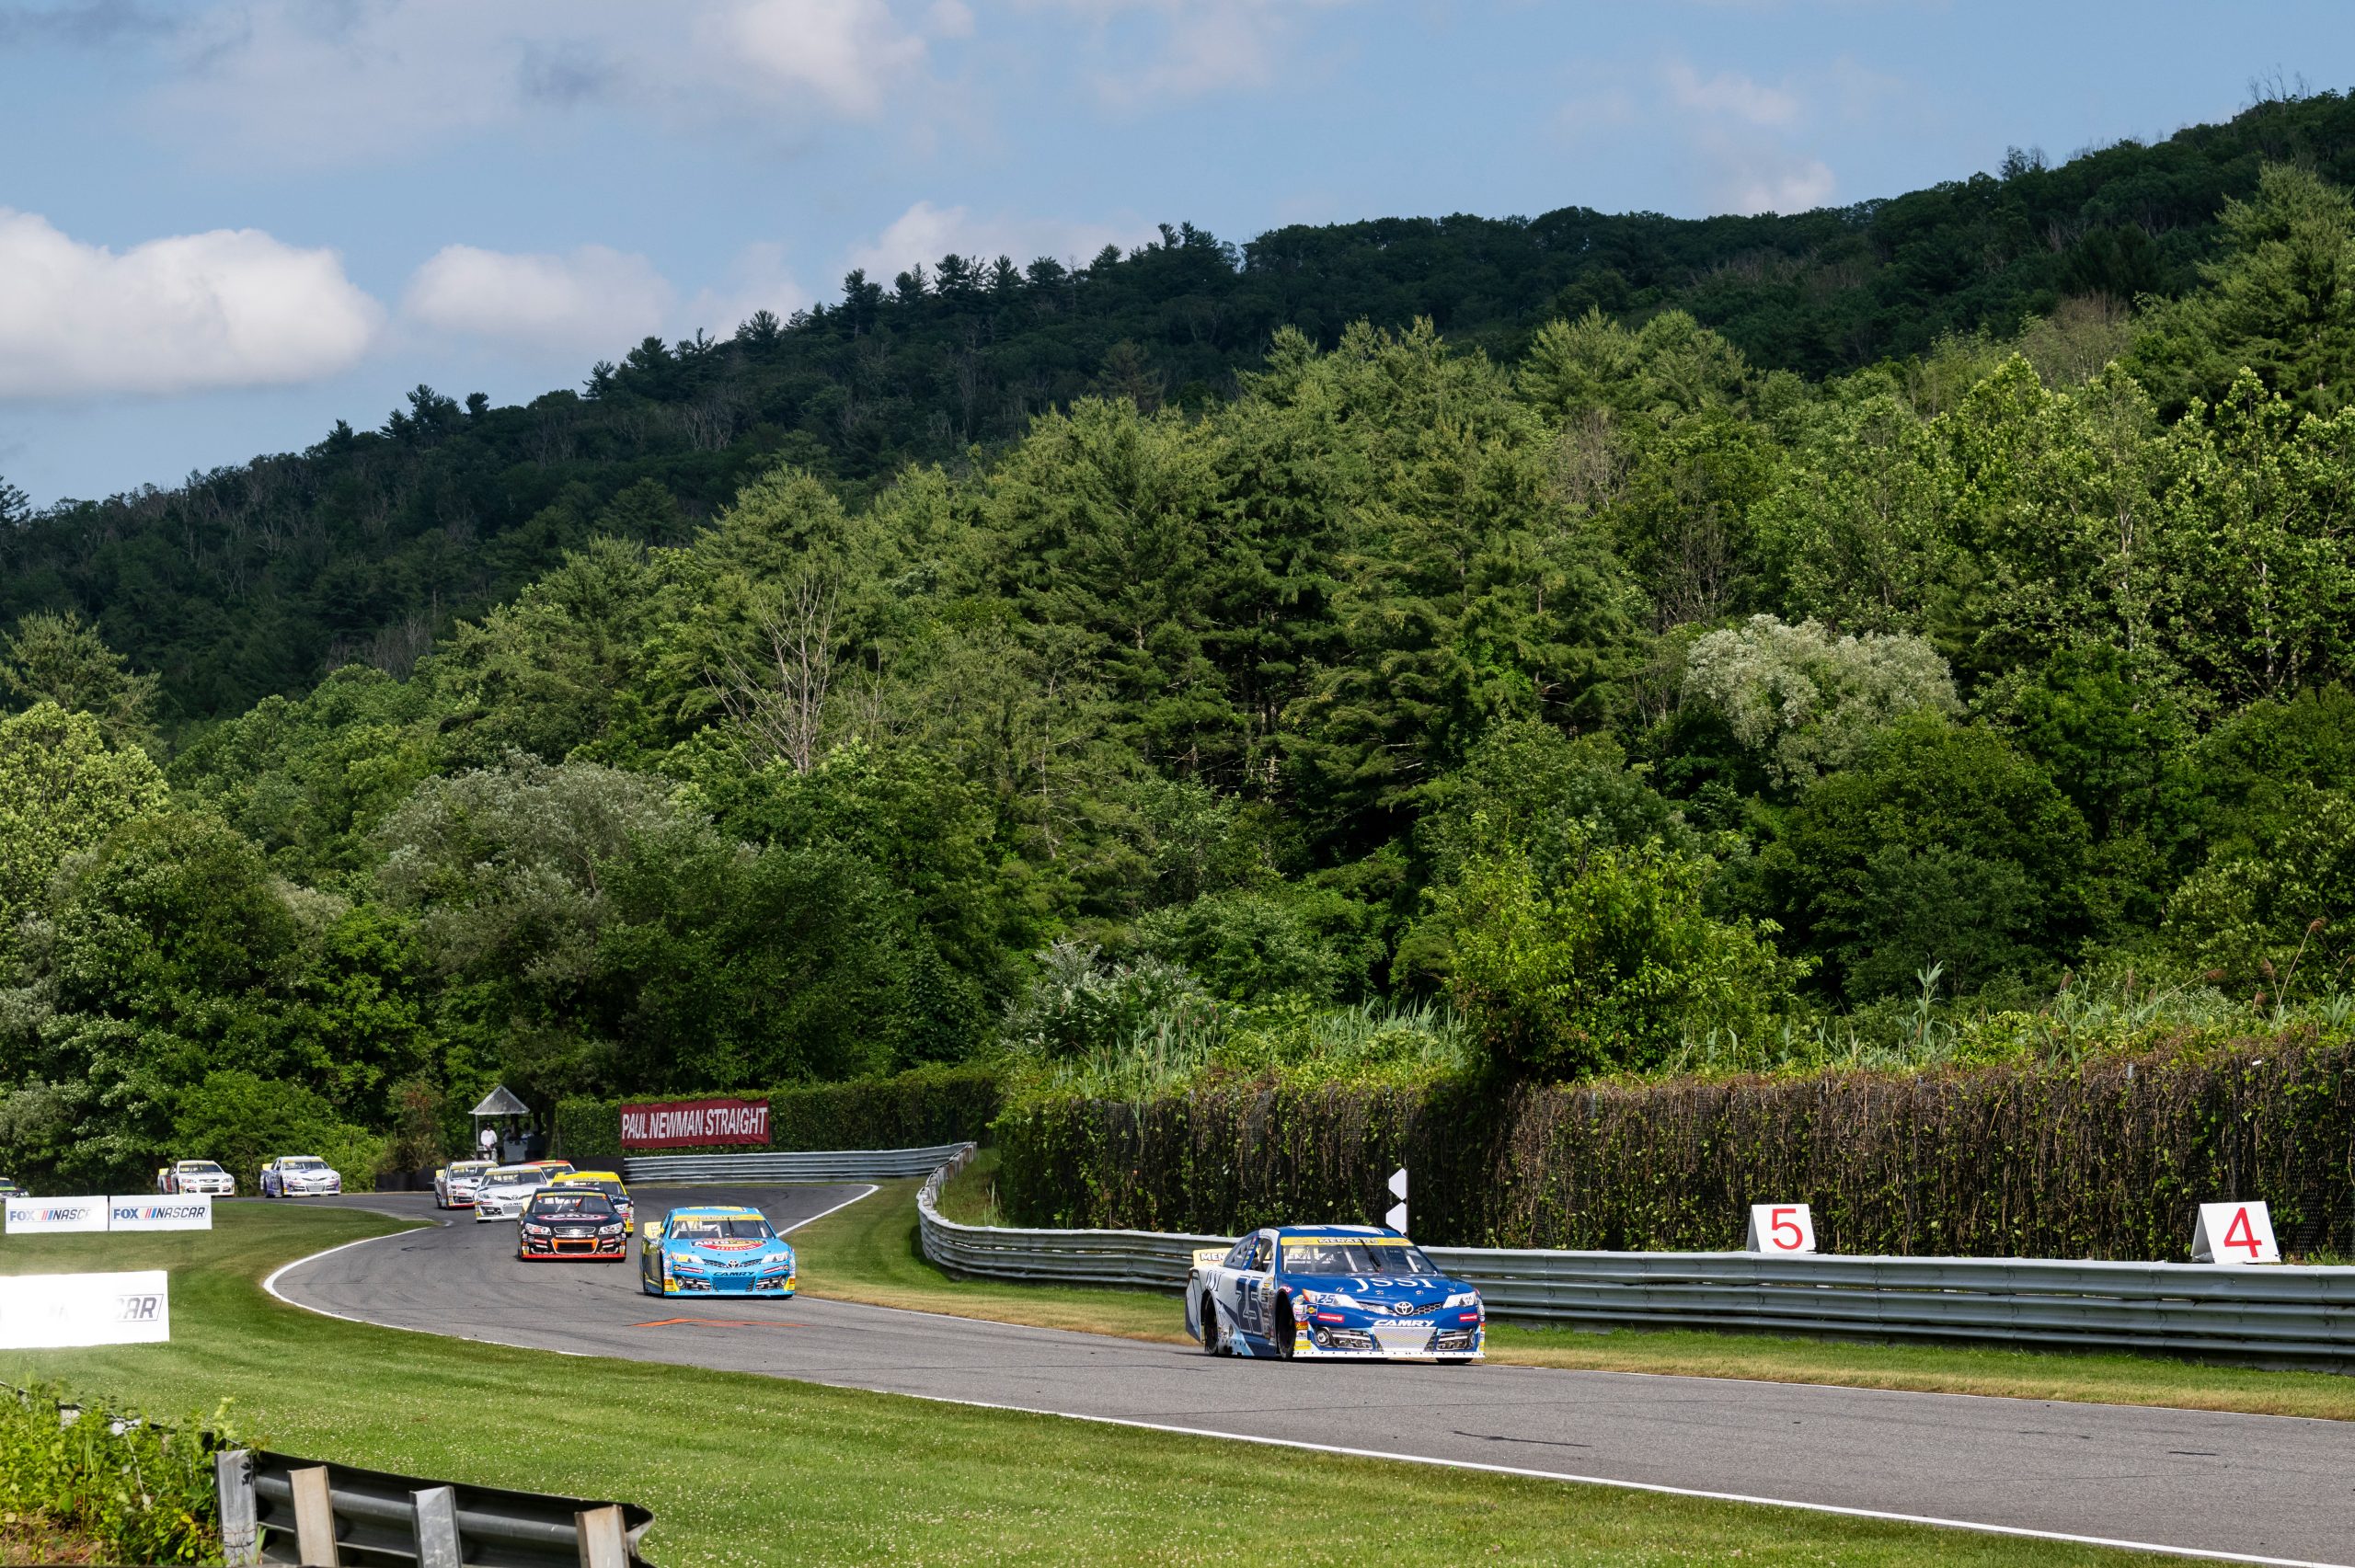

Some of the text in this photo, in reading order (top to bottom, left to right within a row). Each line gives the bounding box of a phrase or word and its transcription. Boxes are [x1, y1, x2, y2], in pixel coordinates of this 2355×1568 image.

[622, 1107, 767, 1139] PAUL NEWMAN STRAIGHT
[112, 1207, 206, 1219] FOX NASCAR
[1772, 1208, 1803, 1250] 5
[2223, 1207, 2262, 1258] 4
[1350, 1277, 1437, 1293] JSSI
[1317, 1294, 1335, 1304] 25
[1373, 1319, 1435, 1327] CAMRY
